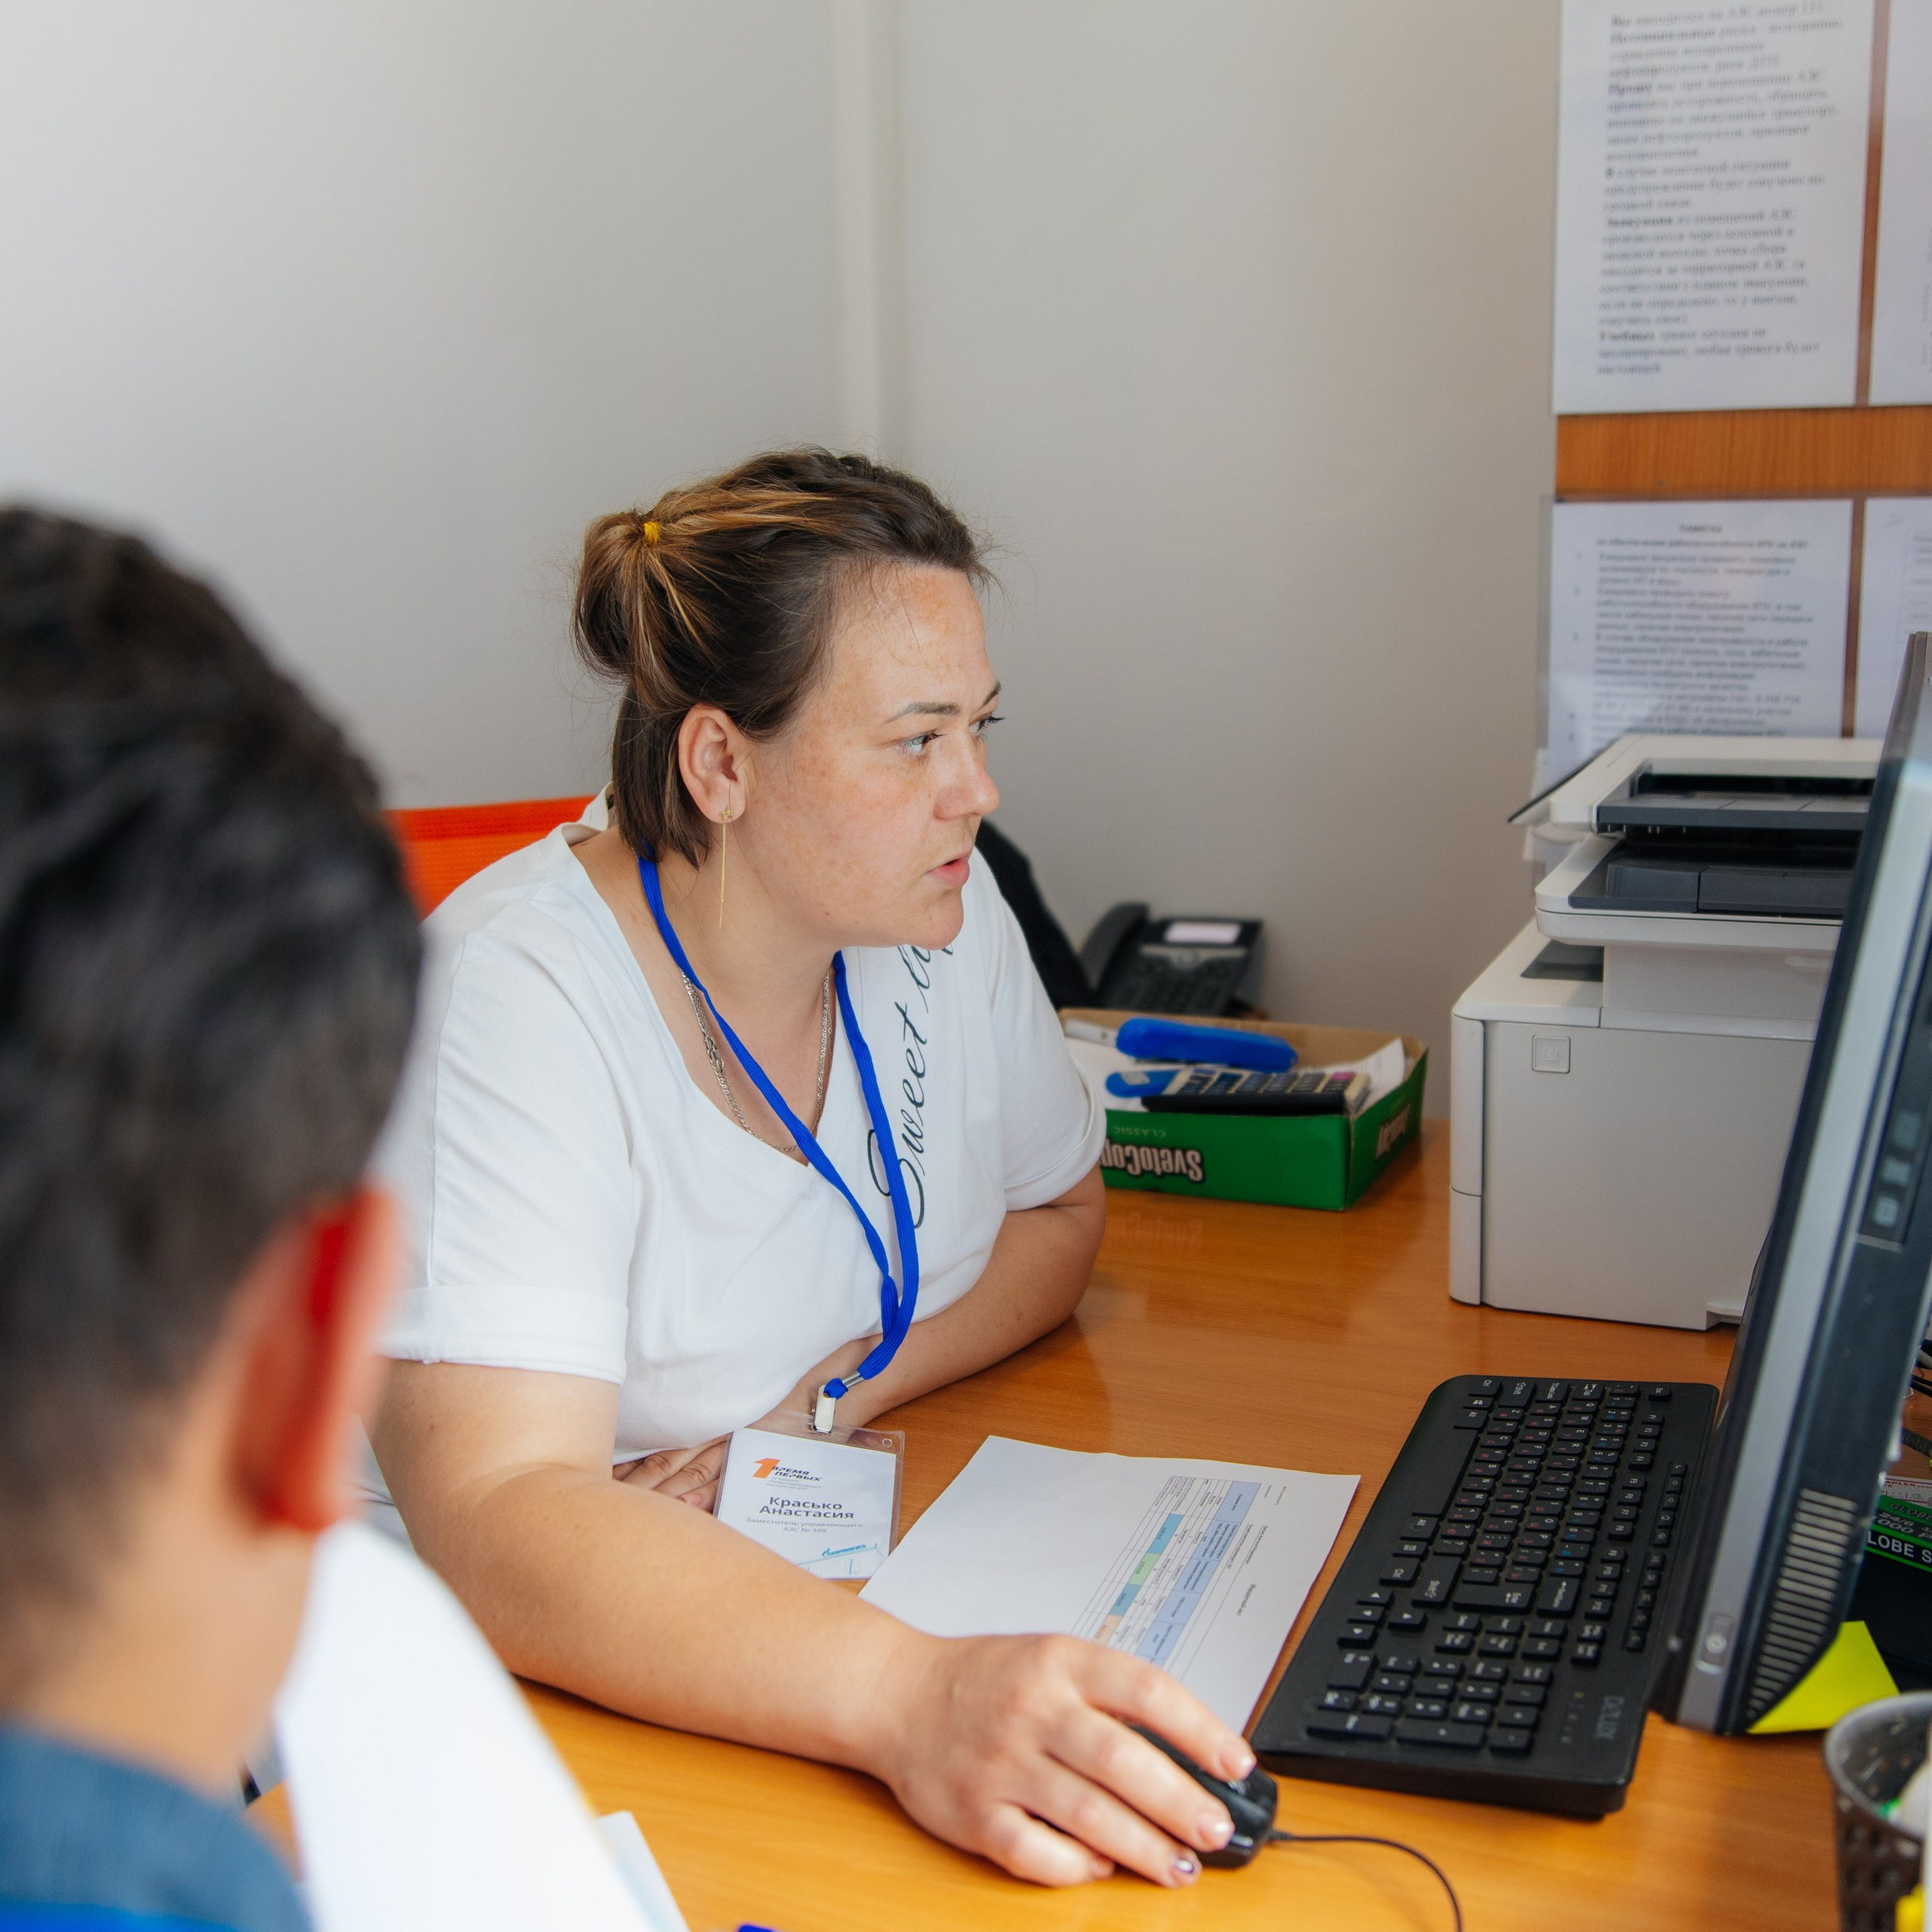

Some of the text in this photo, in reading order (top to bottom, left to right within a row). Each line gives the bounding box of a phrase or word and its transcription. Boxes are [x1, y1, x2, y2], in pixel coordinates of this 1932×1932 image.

[868, 1001, 928, 1229] Sweet
[1113, 1125, 1167, 1138] CLASSIC
[1099, 1137, 1203, 1181] SvetoCop
[772, 1466, 810, 1475] ВРЕМЯ
[775, 1471, 823, 1481] ПЕРВЫХ
[769, 1497, 842, 1510] Красько
[759, 1505, 854, 1519] Анастасия
[1889, 1503, 1932, 1522] GLOBE
[746, 1517, 799, 1526] Заместитель
[1877, 1518, 1914, 1534] 000
[1868, 1531, 1915, 1558] LOBE
